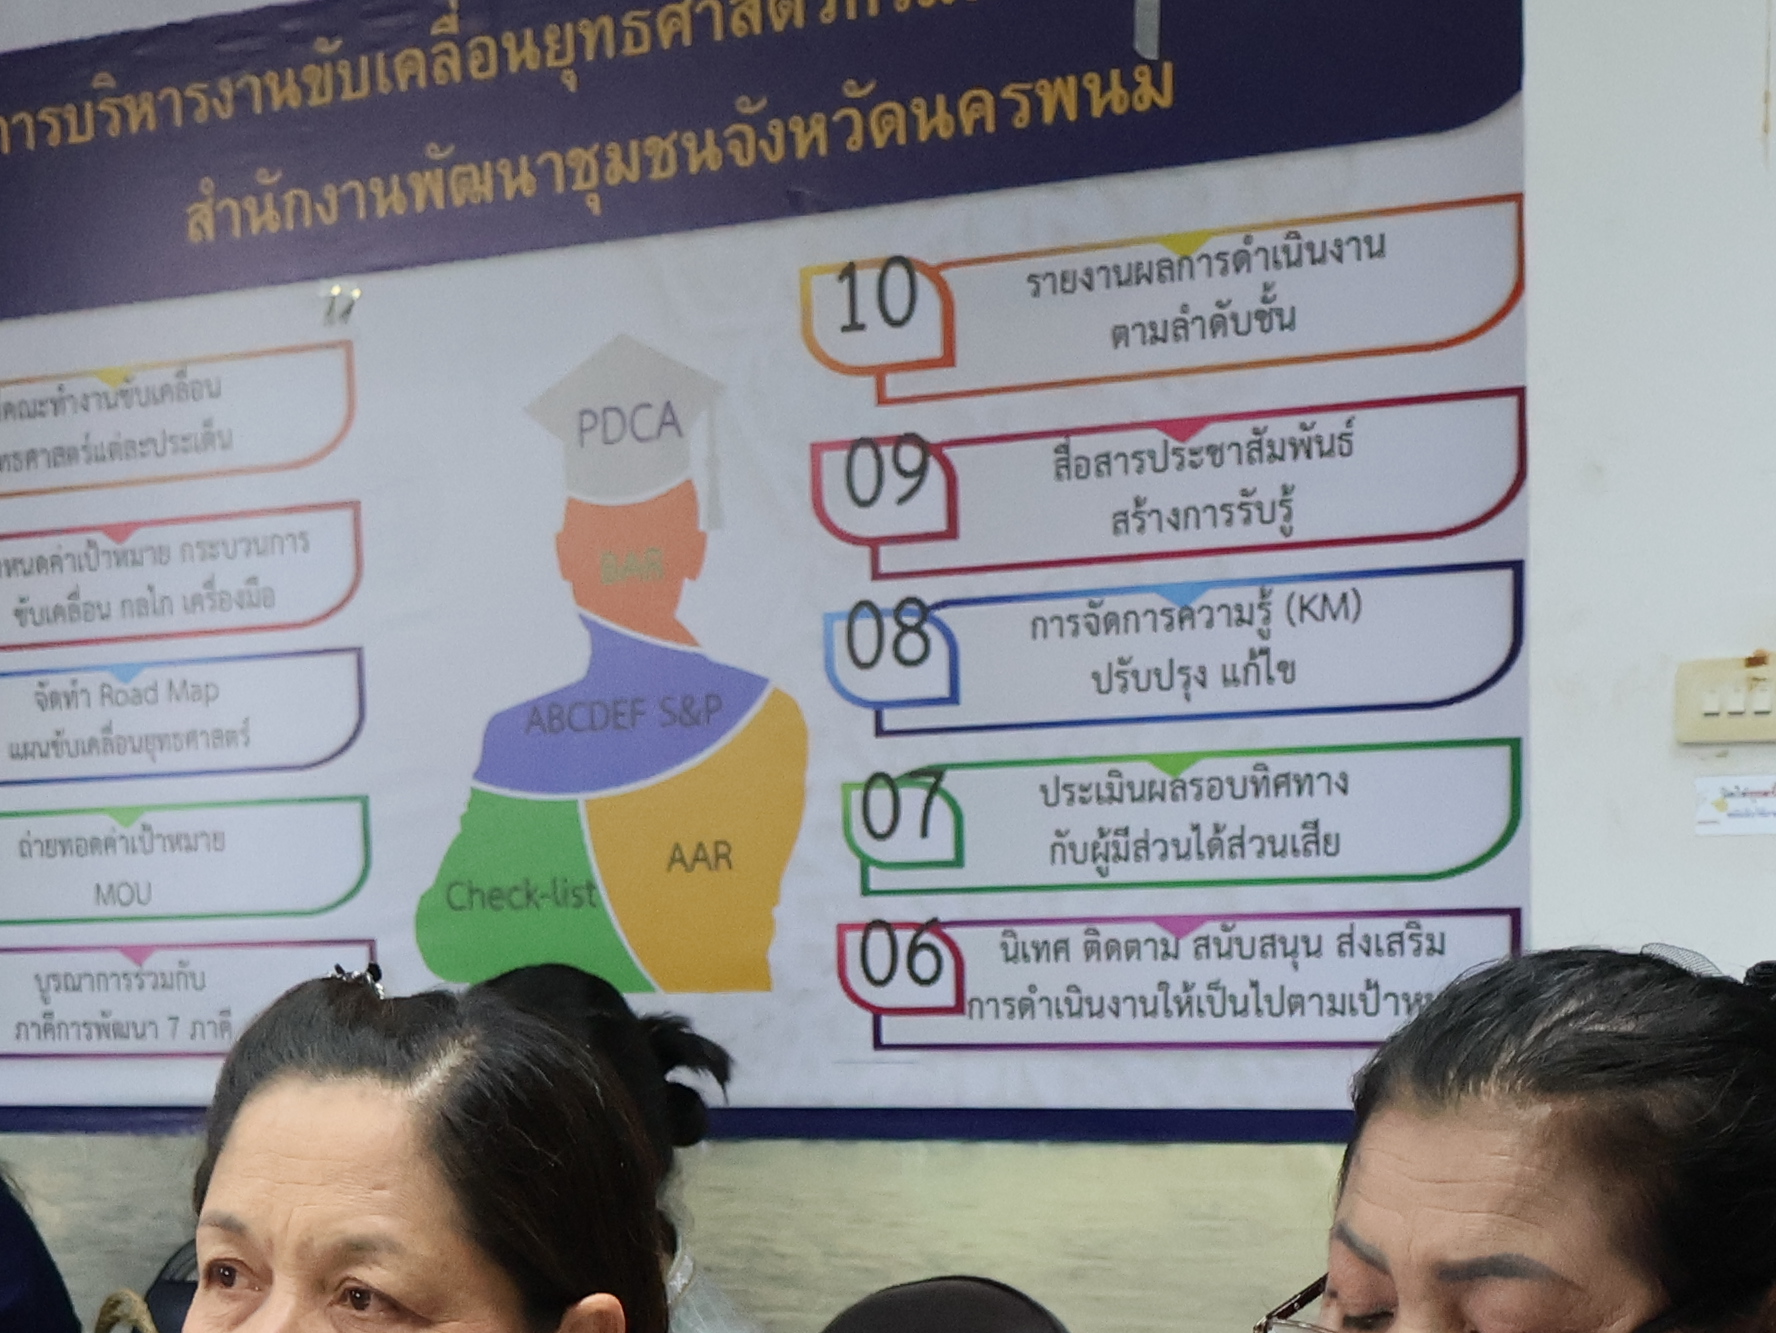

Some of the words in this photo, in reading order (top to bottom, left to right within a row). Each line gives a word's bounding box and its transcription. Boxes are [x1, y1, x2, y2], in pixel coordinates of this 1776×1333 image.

[186, 60, 1175, 245] สำนักงานพัฒนาชุมชนจังหวัดนครพนม
[1026, 230, 1387, 299] รายงานผลการดำเนินงาน
[836, 255, 919, 333] 10
[1112, 282, 1297, 350] ตามลำดับชั้น
[578, 401, 684, 447] PDCA
[1052, 418, 1356, 482] สื่อสารประชาสัมพันธ์
[845, 433, 932, 508] 09
[1112, 485, 1296, 538] สร้างการรับรู้
[845, 597, 932, 671] 08
[1030, 589, 1273, 642] การจัดการความรู้
[1286, 590, 1363, 627] (KM)
[34, 679, 92, 712] จัดทำ
[100, 682, 159, 708] Road
[168, 680, 220, 708] Map
[1091, 657, 1208, 703] ปรับปรุง
[1222, 647, 1297, 690] แก้ไข
[525, 699, 646, 737] ABCDEF
[659, 693, 723, 727] S&P
[861, 768, 946, 841] 07
[1039, 763, 1349, 809] ประเมินผลรอบทิศทาง
[667, 841, 733, 873] AAR
[1049, 818, 1341, 878] กับผู้มีส่วนได้ส่วนเสีย
[94, 881, 153, 908] MOU
[446, 879, 598, 911] Check-list
[860, 918, 944, 987] 06
[1000, 930, 1071, 965] นิเทศ
[1083, 929, 1180, 964] ติดตาม
[1193, 922, 1323, 972] สนับสนุน
[1336, 920, 1446, 959] ส่งเสริม
[968, 977, 1438, 1022] การดำเนินงานให้เป็นไปตามเป้าห
[167, 1015, 180, 1039] 7
